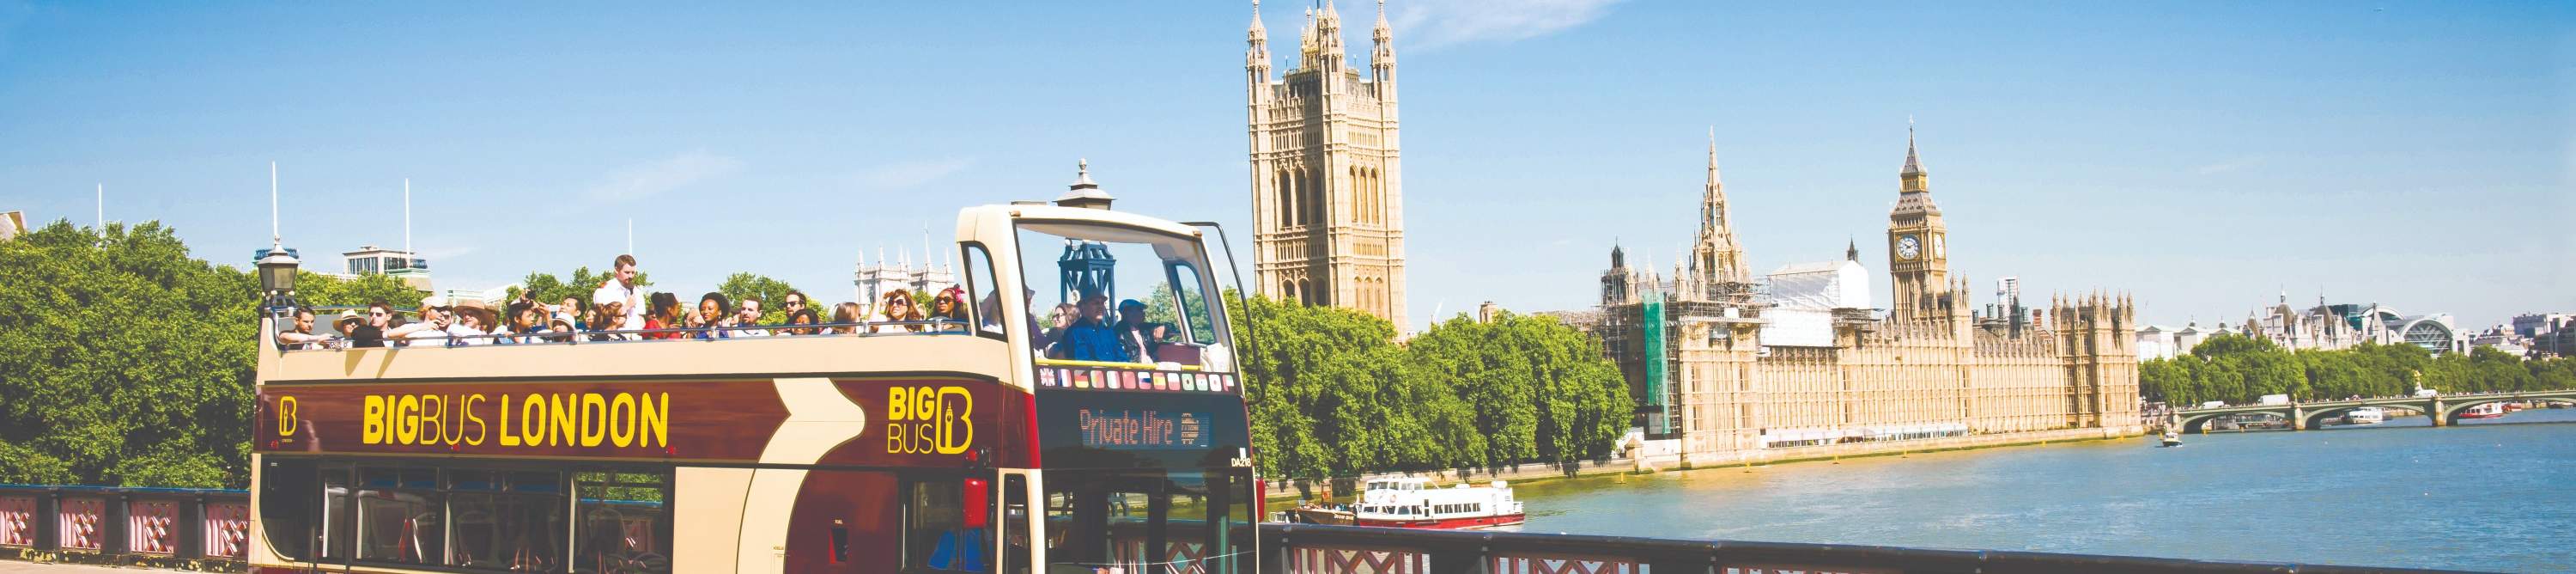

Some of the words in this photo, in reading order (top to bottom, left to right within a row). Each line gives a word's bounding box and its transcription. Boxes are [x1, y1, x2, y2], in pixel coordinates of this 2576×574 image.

[500, 392, 669, 448] LONDON
[888, 386, 935, 421] BIG
[887, 423, 934, 455] BUS
[1079, 409, 1139, 445] Private
[1143, 410, 1173, 445] Hire
